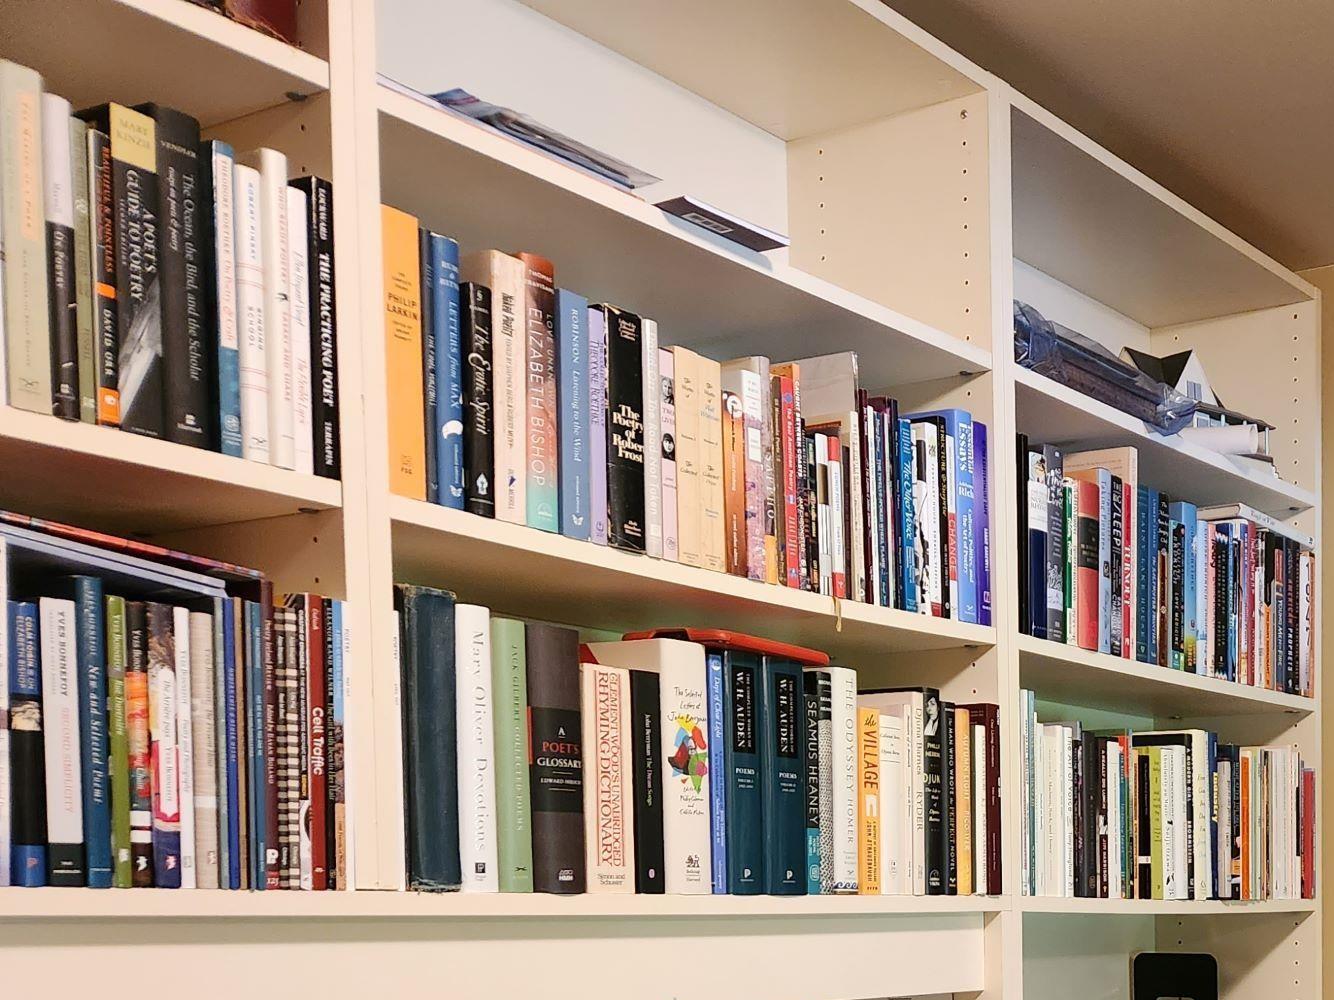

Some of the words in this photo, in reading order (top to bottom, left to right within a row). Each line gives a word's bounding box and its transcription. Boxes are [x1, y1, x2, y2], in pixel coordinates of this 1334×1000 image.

[126, 169, 141, 217] GUIDE
[182, 173, 195, 198] The
[128, 220, 140, 240] TO
[143, 209, 154, 219] A
[182, 199, 196, 238] Ocean,
[143, 220, 157, 274] POET'S
[185, 241, 196, 260] the
[128, 242, 142, 301] POETRY
[185, 263, 197, 290] Bird,
[319, 252, 331, 282] THE
[186, 292, 197, 315] and
[102, 309, 113, 348] DAVID
[188, 318, 199, 336] the
[319, 284, 332, 366] PRACTICING
[449, 301, 458, 352] LETTERS
[474, 324, 490, 350] The
[546, 314, 554, 344] LOVE
[572, 309, 580, 364] ROBINSON
[104, 352, 114, 376] ORR
[189, 337, 199, 381] Scholar
[447, 355, 460, 380] from
[469, 352, 492, 393] Erotic
[529, 307, 543, 409] ELIZABETH
[322, 369, 334, 407] POET
[450, 383, 460, 408] MAX
[470, 397, 492, 434] Spirit
[573, 420, 582, 435] the
[620, 405, 640, 419] The
[531, 416, 545, 486] BISHOP
[573, 438, 583, 462] Wind
[624, 429, 636, 439] of
[649, 420, 659, 452] Road
[958, 422, 968, 471] Essays
[649, 456, 659, 478] Not
[649, 481, 659, 515] Taken
[764, 454, 775, 519] SAPPHO
[57, 611, 65, 638] YVES
[58, 641, 68, 696] BONNEFOY
[468, 630, 484, 679] Mary
[510, 644, 519, 671] JACK
[88, 665, 99, 689] New
[735, 671, 744, 685] W.
[736, 688, 744, 701] H.
[780, 678, 787, 692] W.
[844, 678, 854, 709] THE
[89, 693, 100, 715] and
[472, 685, 486, 745] Oliver
[511, 675, 521, 723] GILBERT
[597, 671, 610, 754] RHYMING
[609, 671, 620, 734] CLEMENT
[780, 694, 787, 707] H.
[312, 706, 324, 734] Cell
[643, 714, 652, 729] John
[736, 703, 746, 748] AUDEN
[780, 710, 789, 753] AUDEN
[807, 700, 818, 760] SEAMUS
[90, 719, 102, 764] Selected
[311, 736, 325, 776] Traffic
[513, 726, 522, 794] COLLECTED
[542, 741, 579, 754] POET'S
[610, 734, 620, 783] WOOD'S
[845, 718, 855, 793] ODYSSEY
[646, 756, 654, 769] The
[735, 766, 755, 775] POEMS
[862, 730, 879, 791] VILLAGE
[92, 769, 103, 805] Poems
[473, 757, 488, 852] Devotions
[808, 765, 819, 825] HEANEY
[515, 796, 524, 831] POEMS
[599, 756, 612, 866] DICTIONARY
[610, 784, 622, 868] UNABRIDGED
[847, 799, 855, 844] HOMER
[916, 790, 924, 832] RYDER
